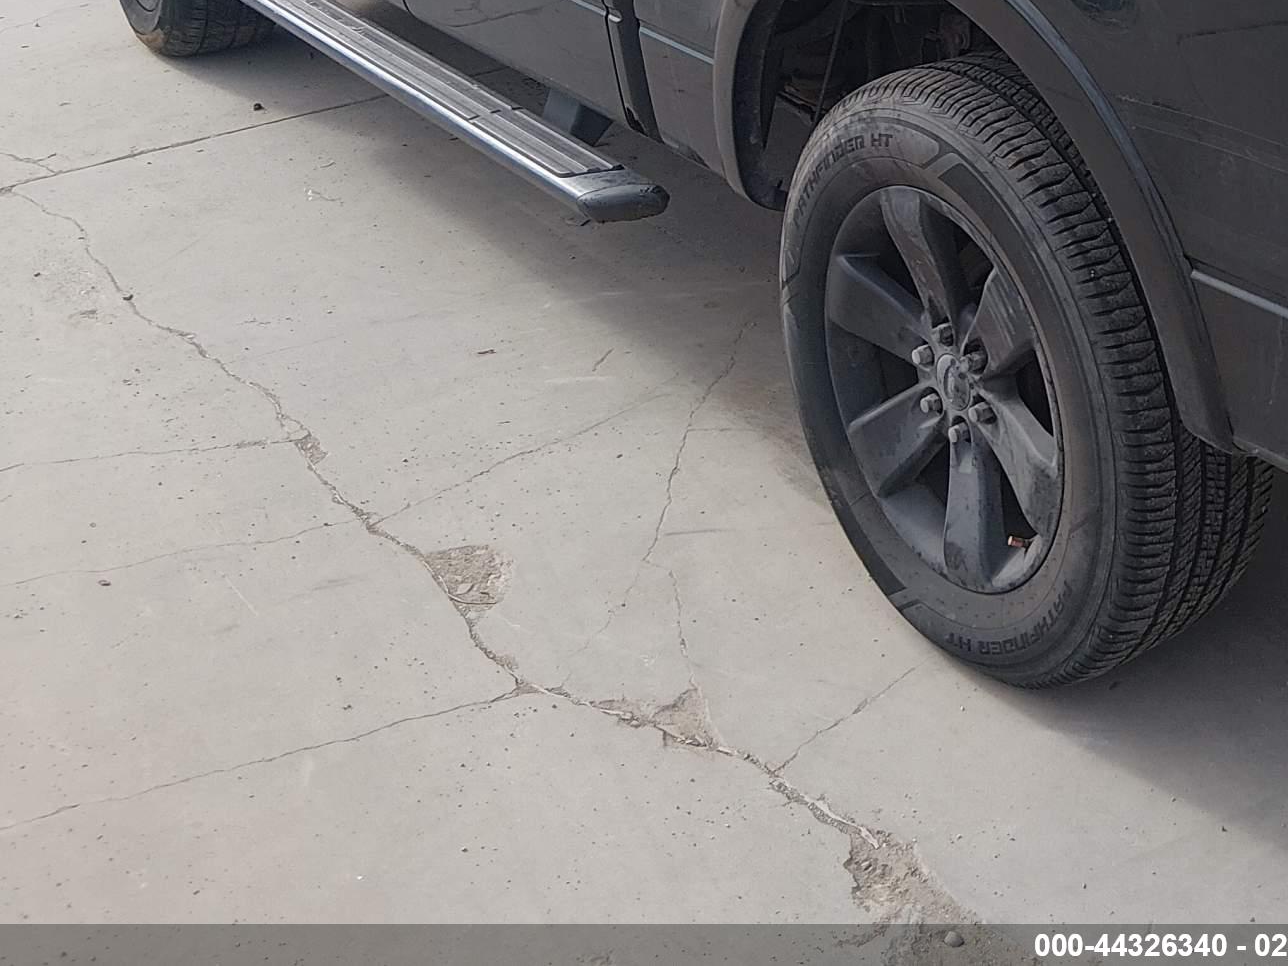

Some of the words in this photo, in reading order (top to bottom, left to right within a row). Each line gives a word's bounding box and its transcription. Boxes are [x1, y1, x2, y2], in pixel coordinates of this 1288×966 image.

[793, 134, 865, 231] PATHFINDER
[870, 133, 894, 148] HT
[945, 632, 972, 652] HT
[978, 580, 1074, 655] PATHFINDER
